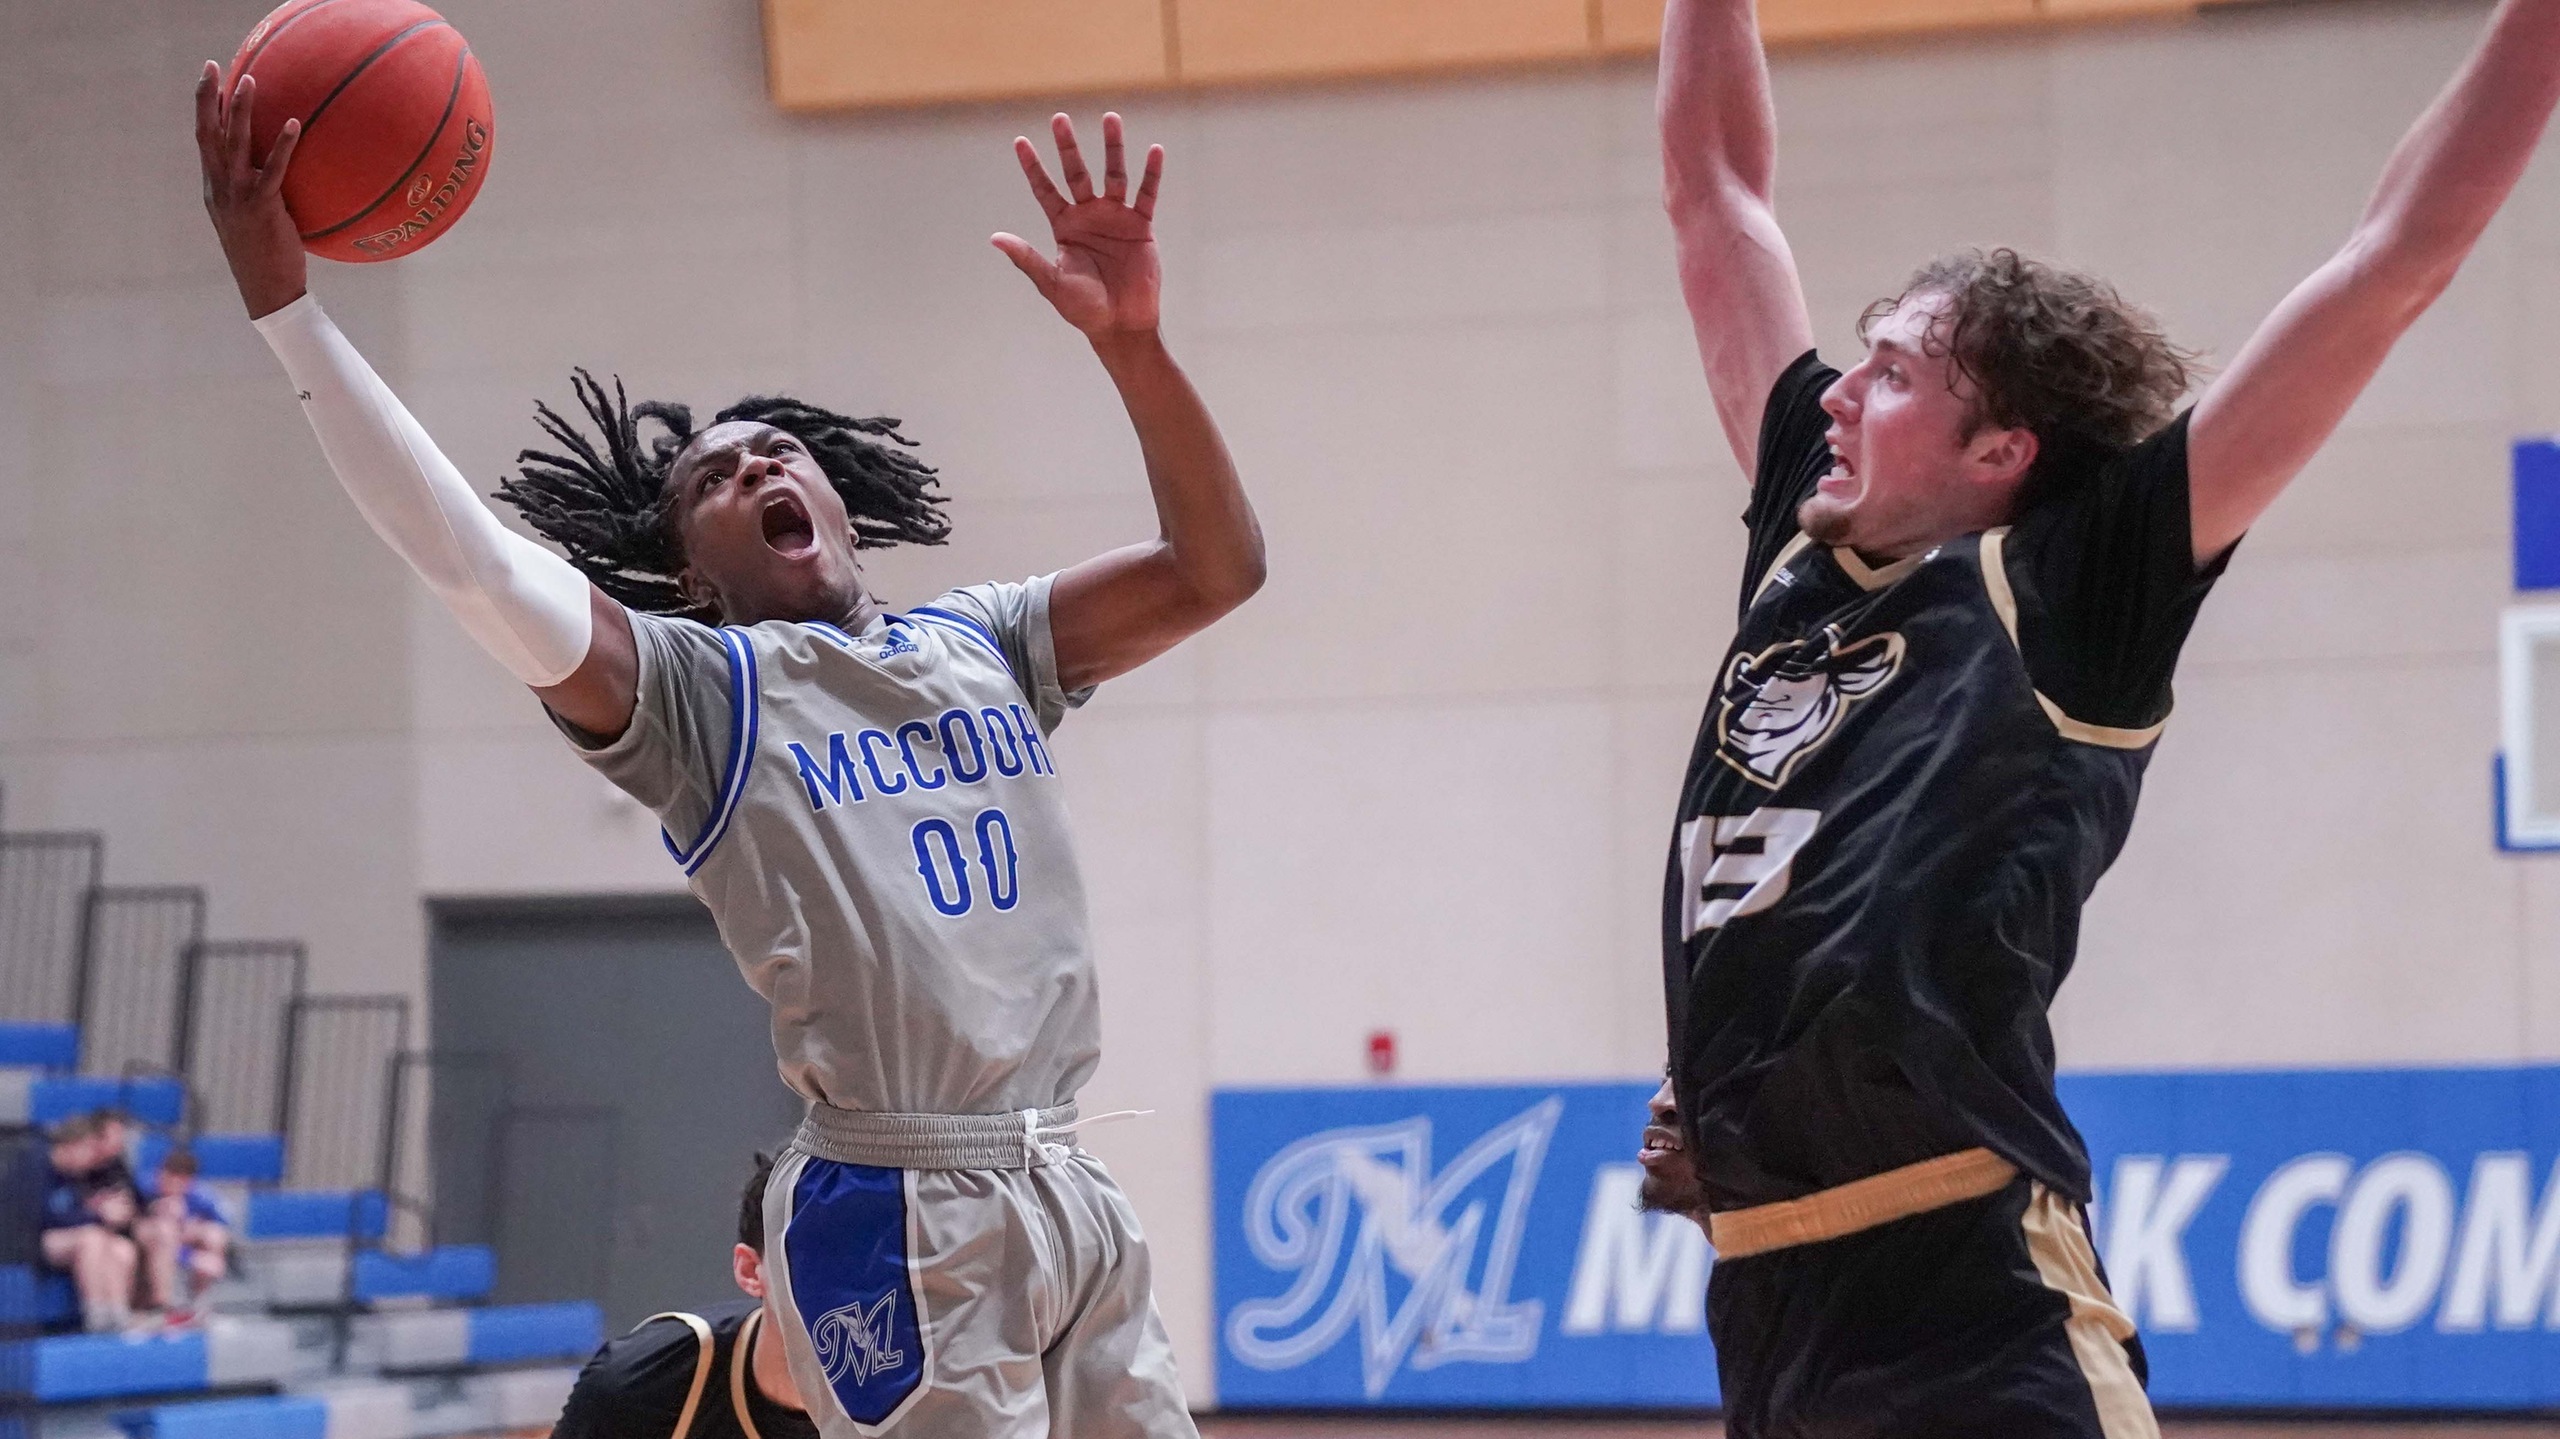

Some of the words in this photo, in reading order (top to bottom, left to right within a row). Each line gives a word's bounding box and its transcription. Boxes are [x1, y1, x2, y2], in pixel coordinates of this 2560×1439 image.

[352, 117, 487, 256] SPALDING
[879, 641, 919, 660] adidas
[909, 806, 1019, 917] 00
